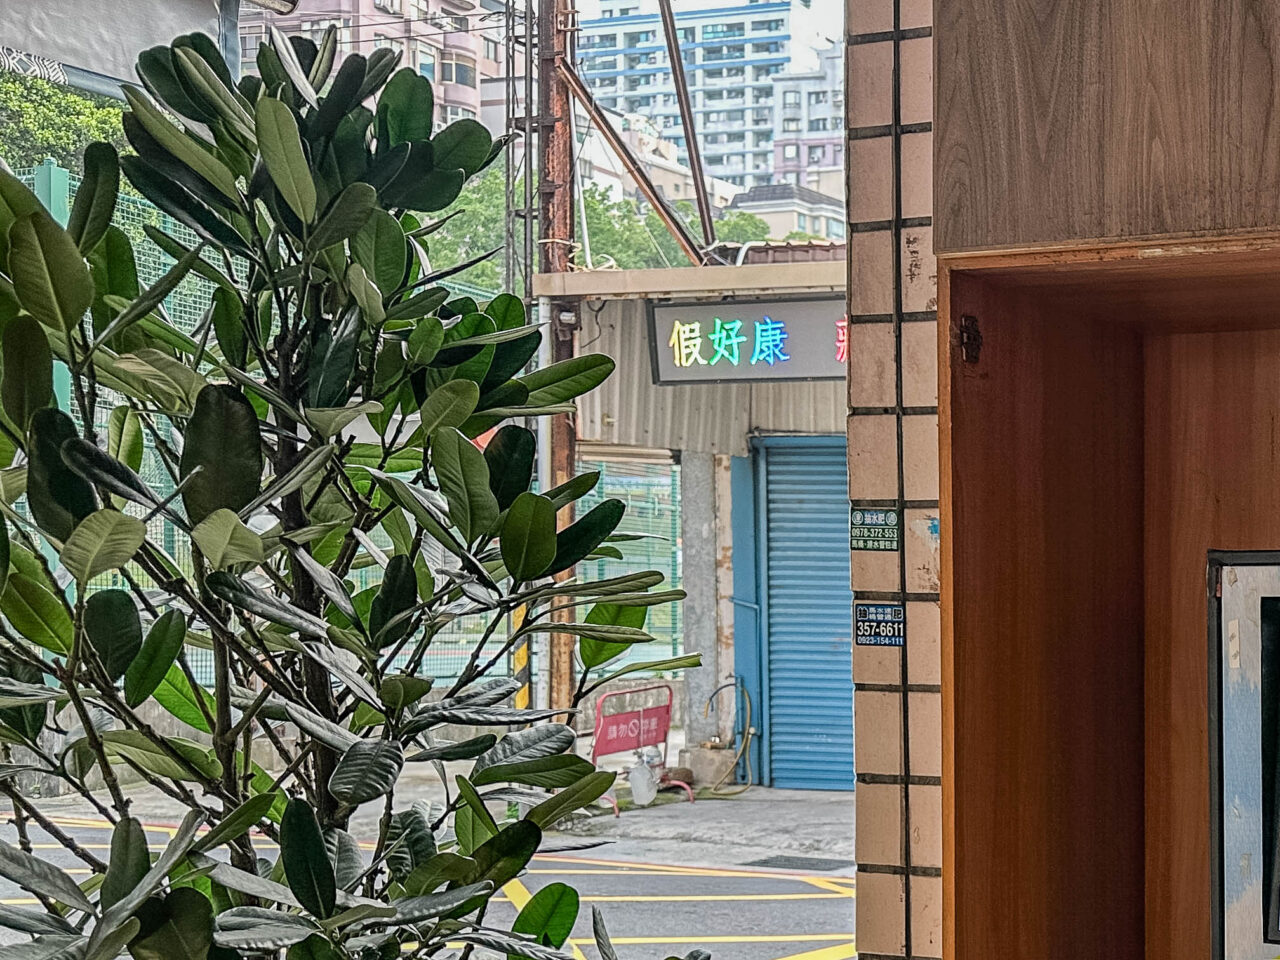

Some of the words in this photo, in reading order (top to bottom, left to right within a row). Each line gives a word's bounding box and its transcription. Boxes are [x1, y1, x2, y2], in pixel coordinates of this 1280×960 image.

[669, 316, 790, 367] 假好康
[857, 622, 904, 637] 357-6611
